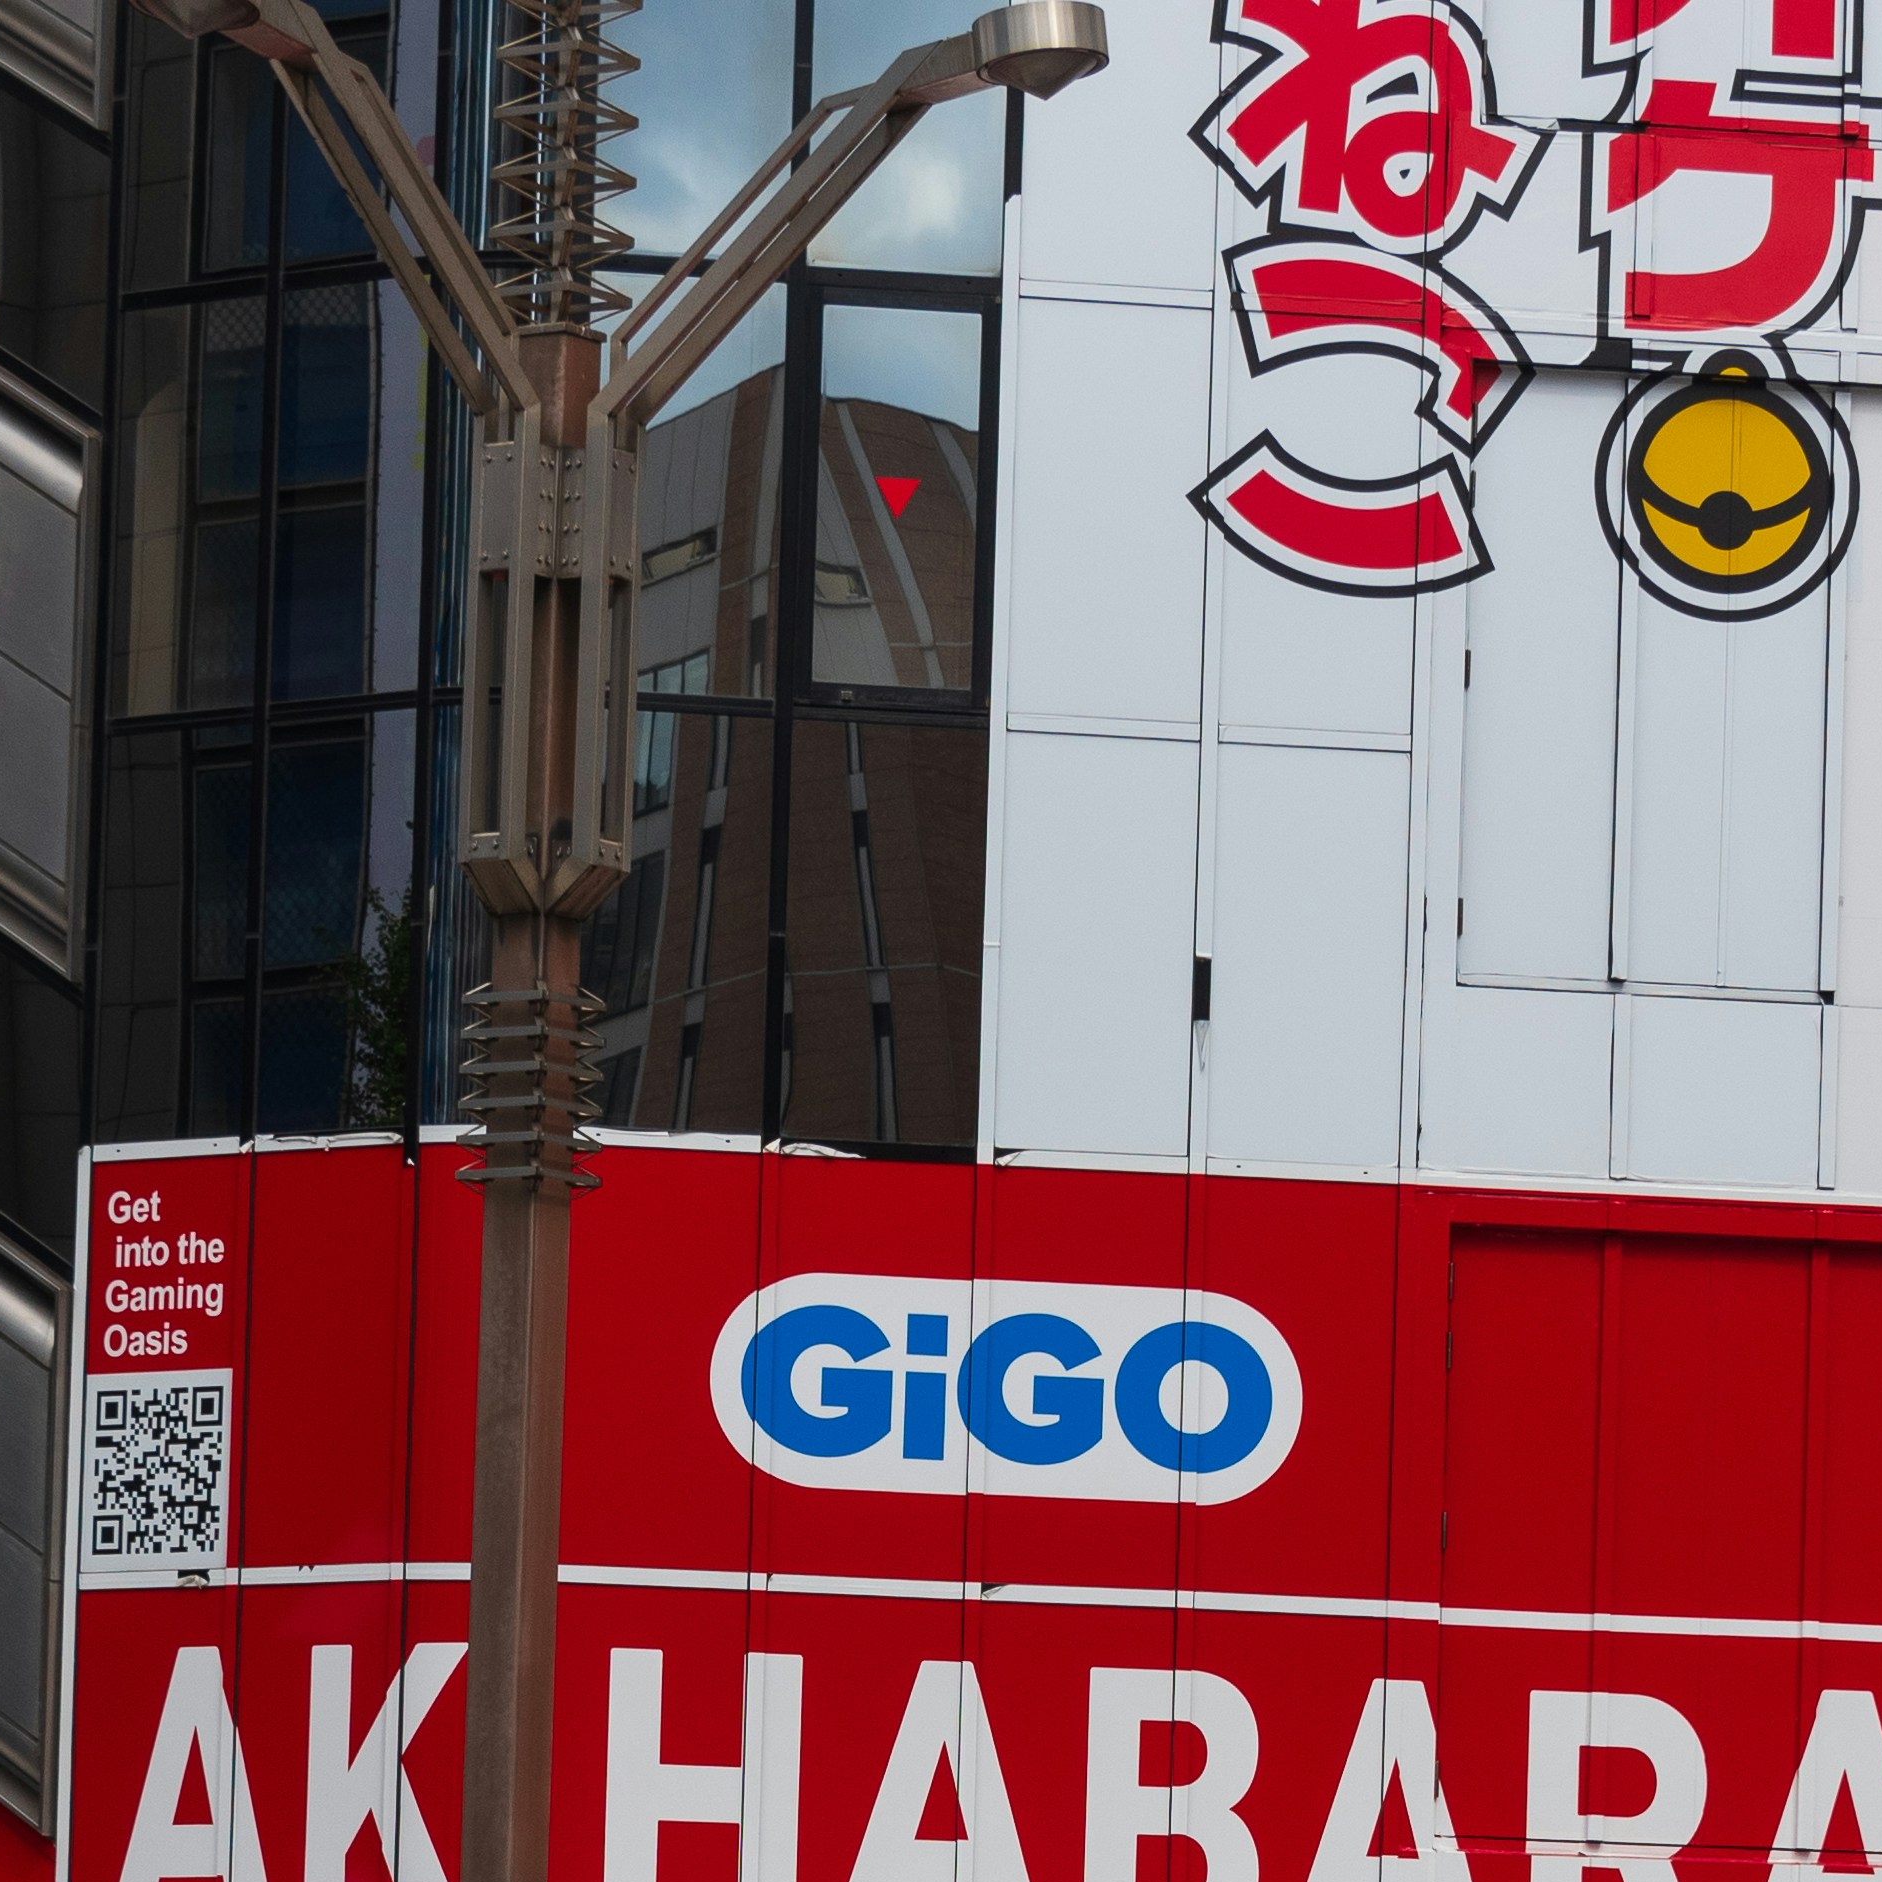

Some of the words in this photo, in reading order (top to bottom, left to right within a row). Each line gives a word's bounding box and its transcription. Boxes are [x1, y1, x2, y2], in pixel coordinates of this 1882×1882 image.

[107, 1190, 161, 1224] Get
[115, 1235, 170, 1268] into
[178, 1232, 225, 1265] the
[105, 1278, 224, 1317] Gaming
[103, 1322, 188, 1357] Oasis
